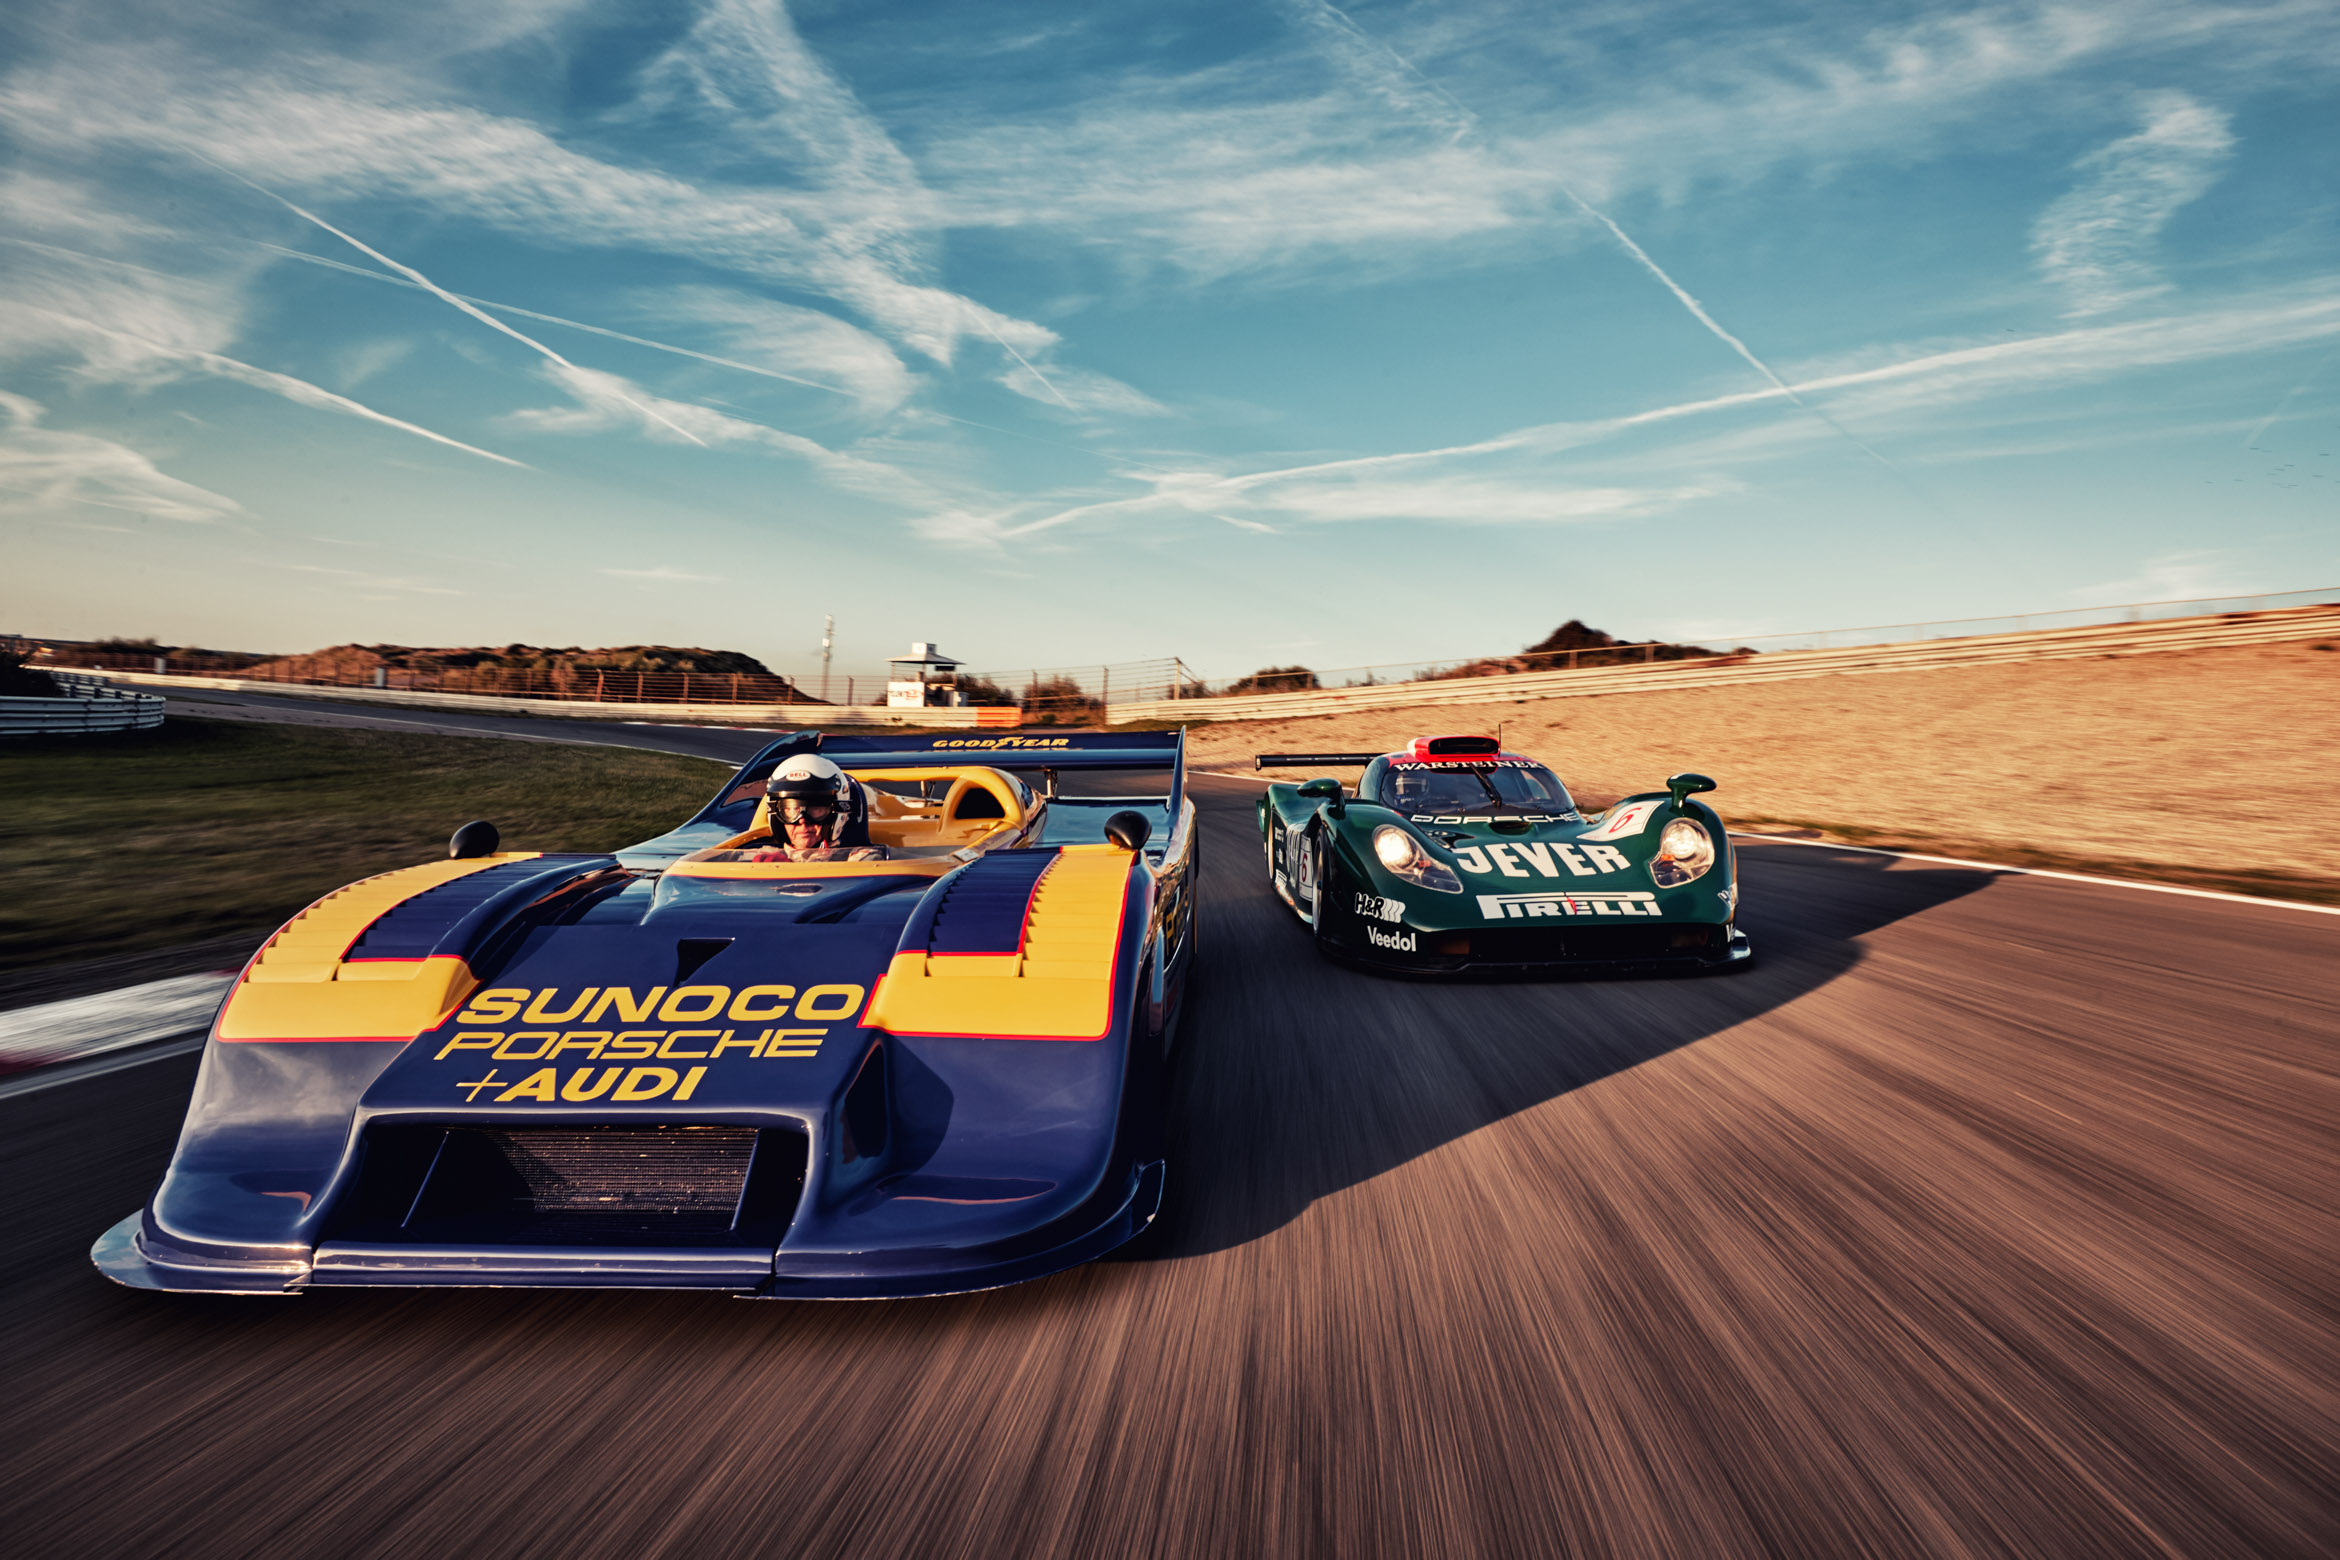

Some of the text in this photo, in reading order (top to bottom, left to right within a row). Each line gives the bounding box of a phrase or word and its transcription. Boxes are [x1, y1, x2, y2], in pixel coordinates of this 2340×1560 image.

[1393, 761, 1545, 771] WARSTEINER
[1411, 812, 1580, 824] PORSCHE
[1608, 807, 1642, 833] 6
[1302, 853, 1308, 882] 6
[1450, 842, 1631, 878] JEVER
[1355, 892, 1386, 918] H&R
[1476, 892, 1662, 919] PIRELLI
[1367, 926, 1416, 952] Veedol
[456, 984, 865, 1024] SUNOCO
[434, 1028, 828, 1060] PORSCHE
